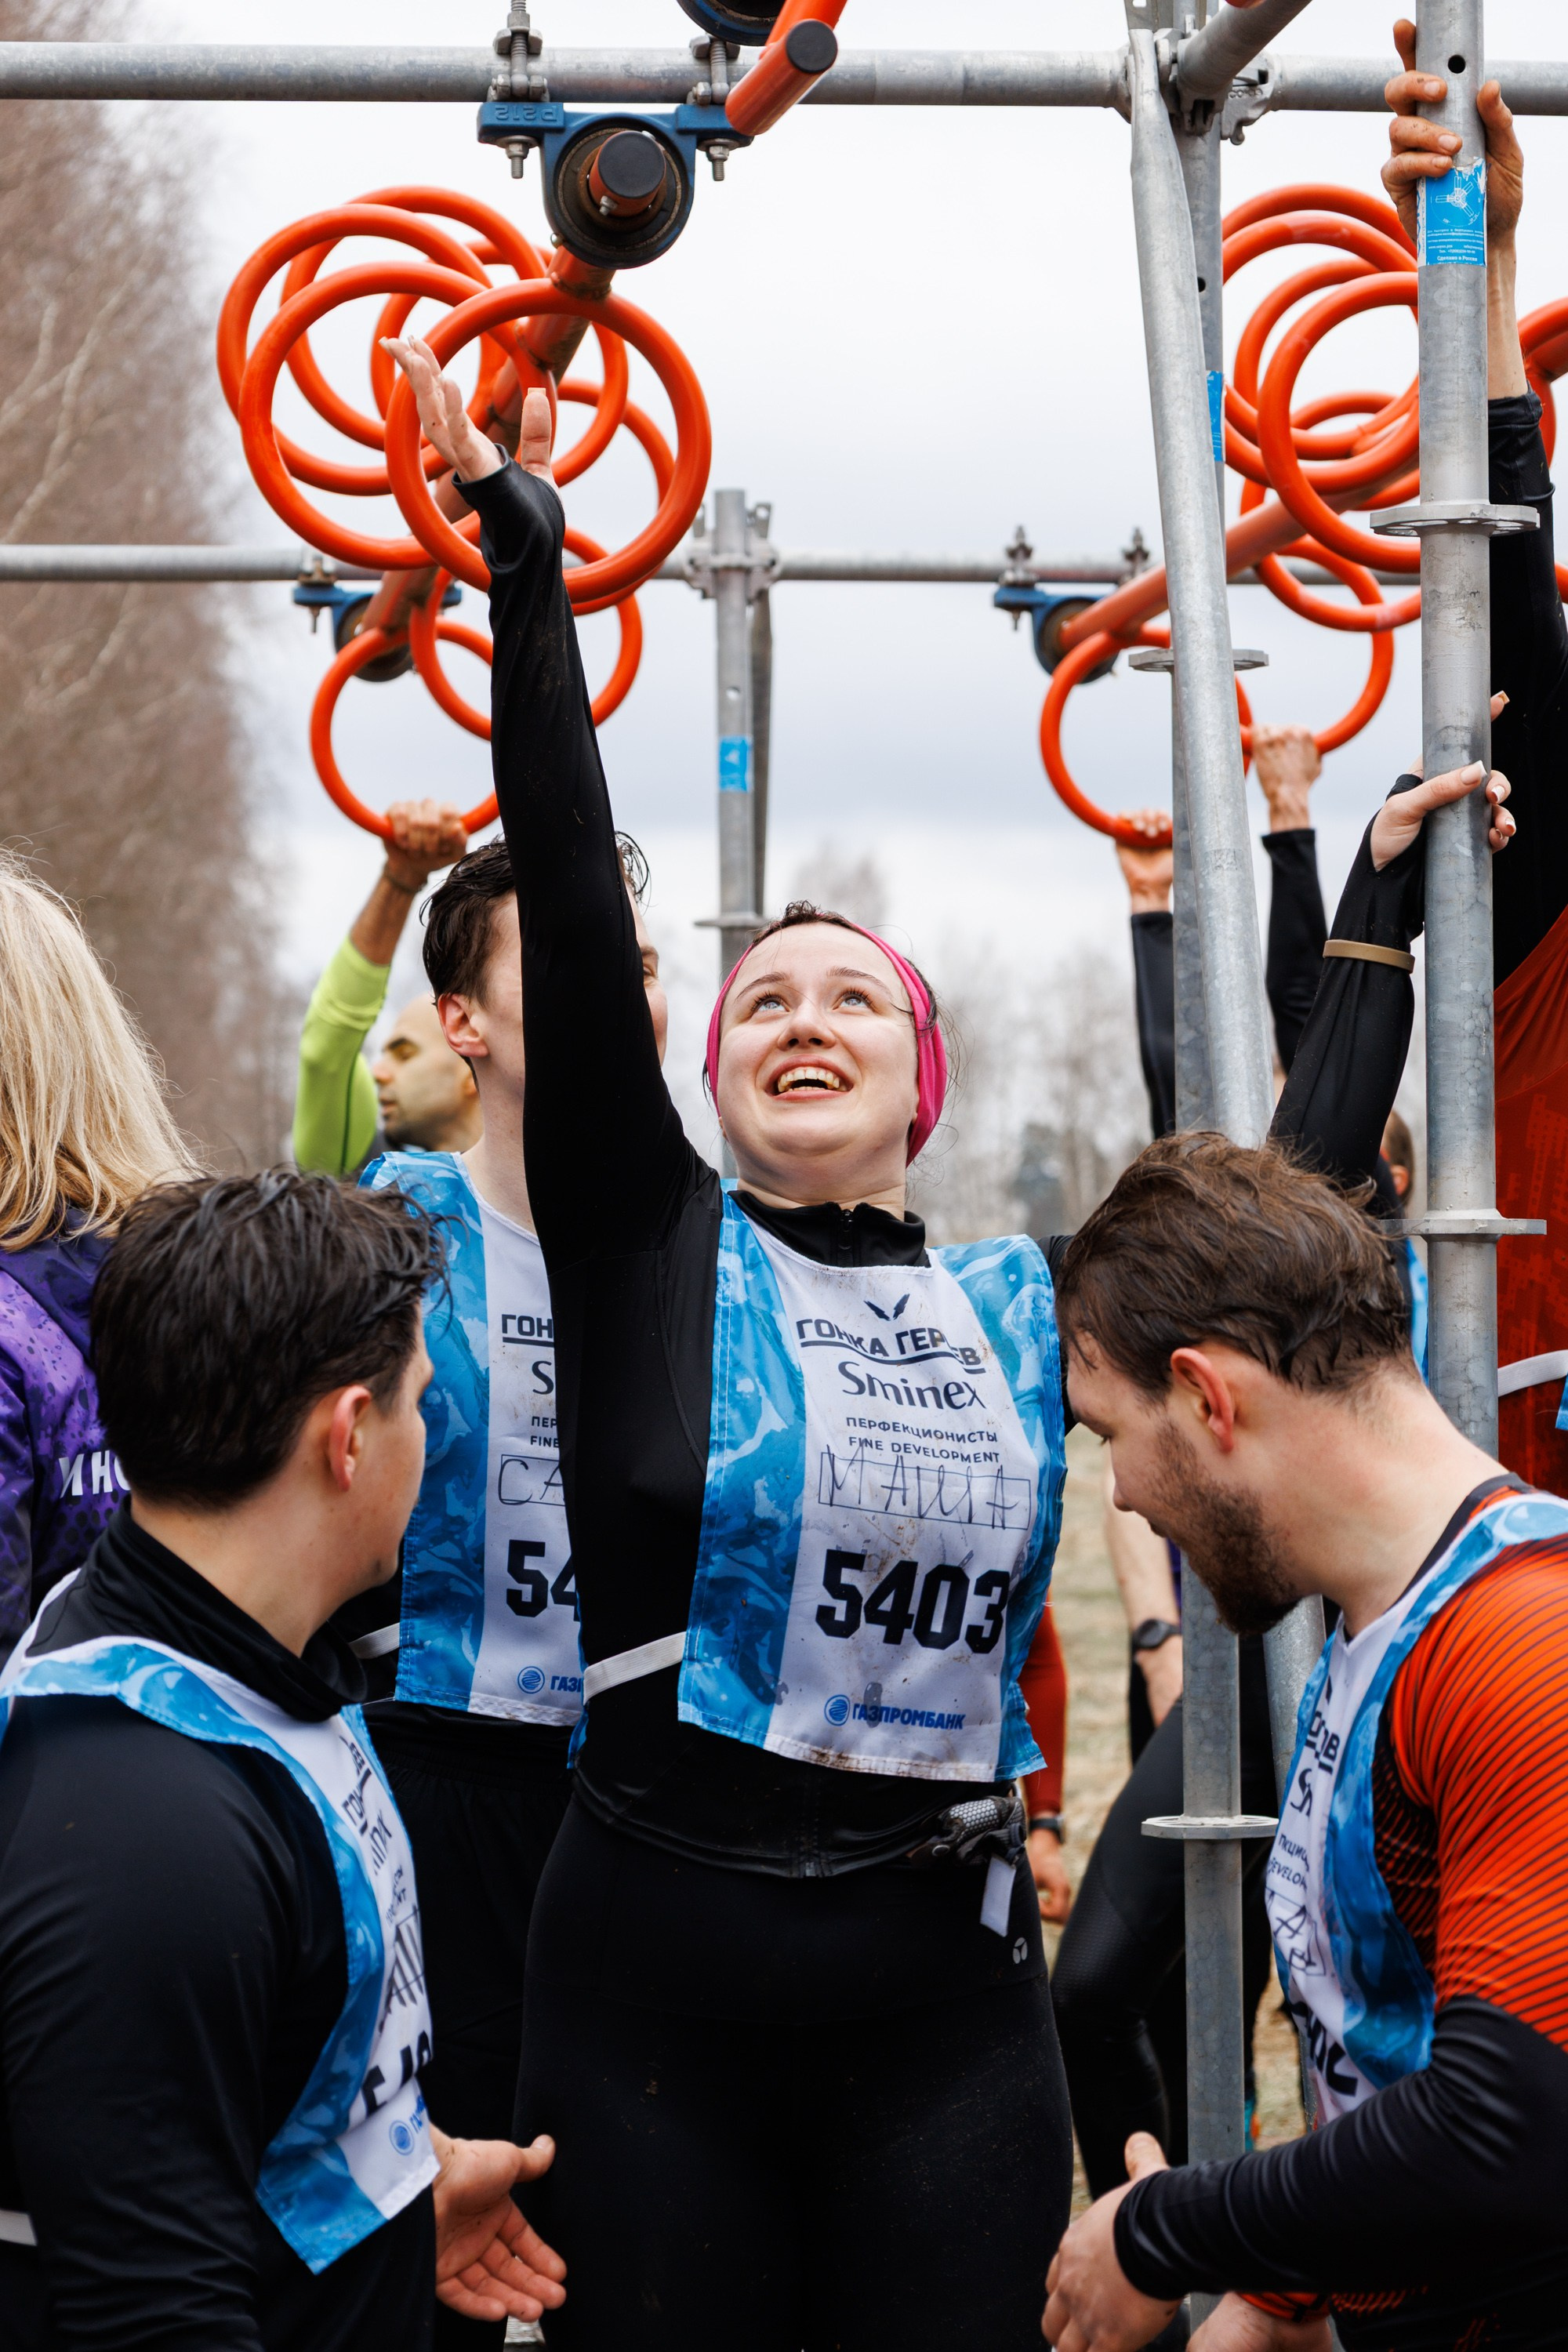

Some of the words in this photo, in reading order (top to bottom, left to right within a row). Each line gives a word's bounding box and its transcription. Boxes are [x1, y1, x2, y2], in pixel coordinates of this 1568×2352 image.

[796, 1319, 890, 1357] ГОНКА
[838, 1361, 987, 1410] Sminex
[846, 1417, 998, 1443] ПЕРФЕКЦИОНИСТЫ
[848, 1436, 884, 1451] FINE
[890, 1443, 1000, 1464] DEVELOPMENT
[815, 1548, 1011, 1655] 5403
[852, 1703, 967, 1730] ГАЗПРОМБАНК
